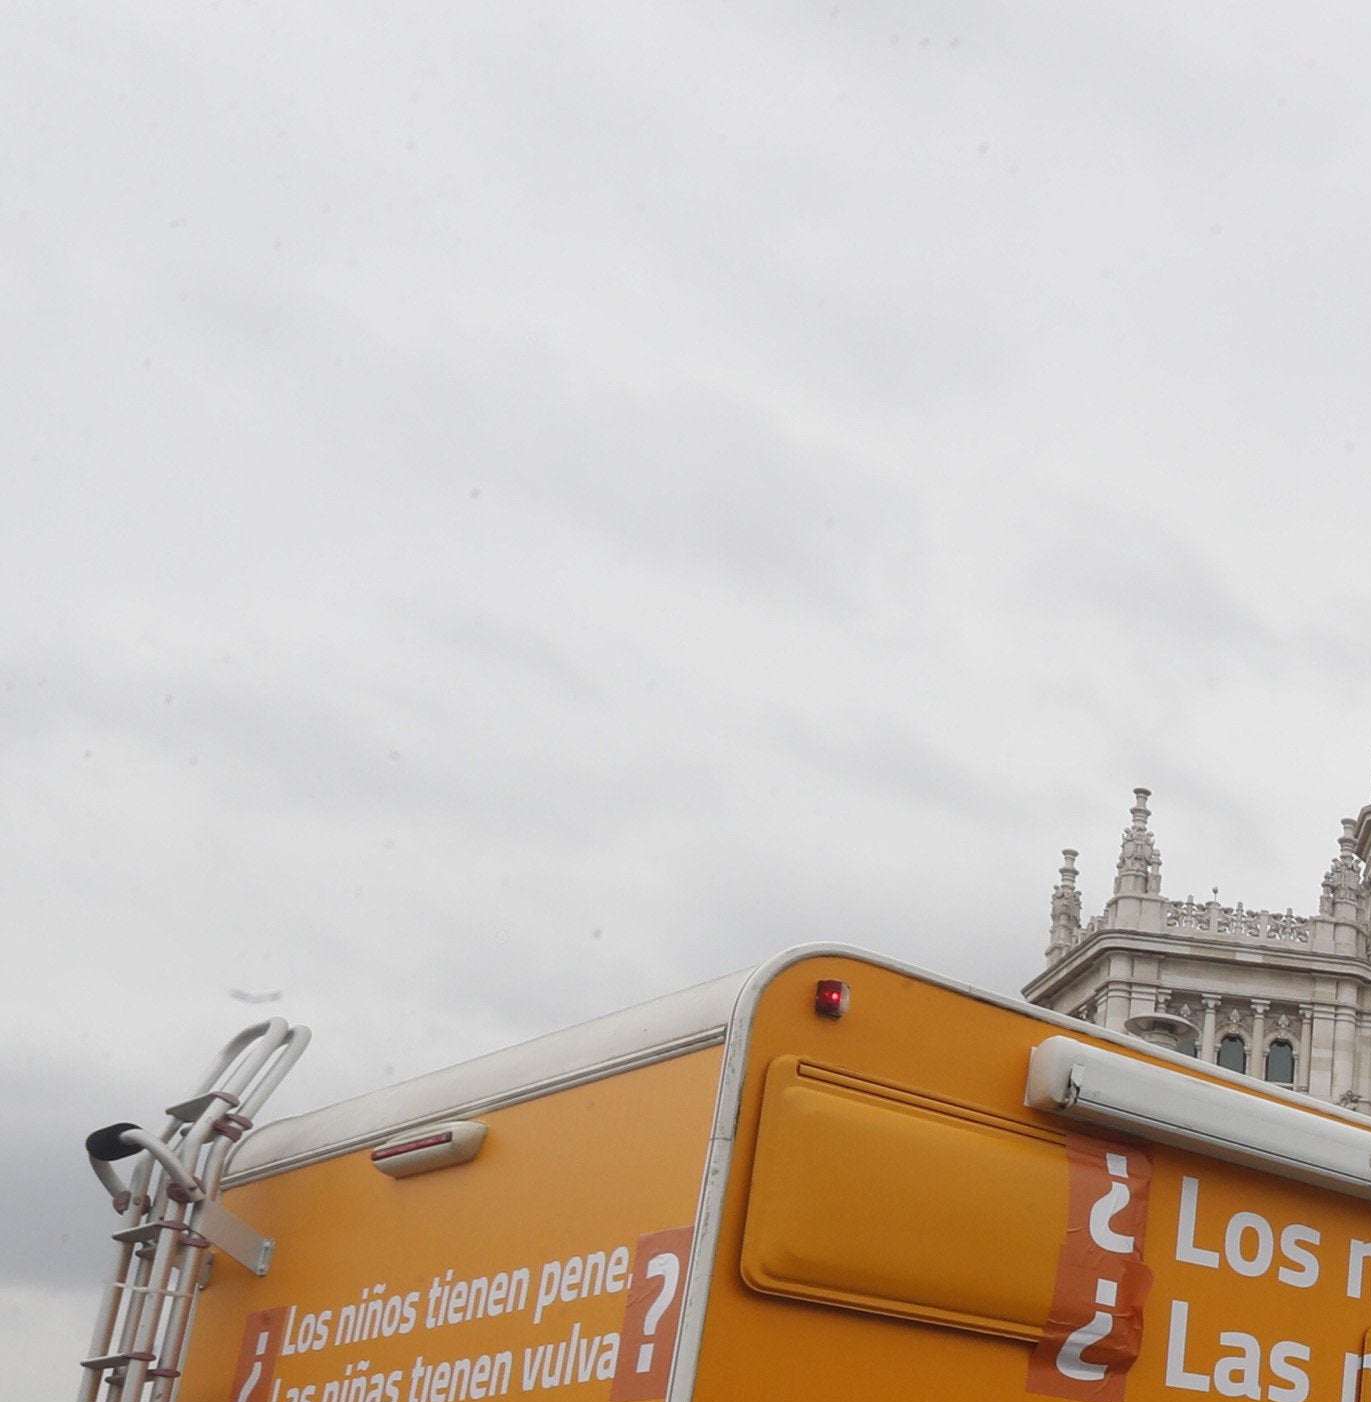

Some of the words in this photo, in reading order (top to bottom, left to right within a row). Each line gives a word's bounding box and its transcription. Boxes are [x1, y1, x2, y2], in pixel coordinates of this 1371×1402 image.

[1175, 1175, 1321, 1289] Los
[281, 1305, 332, 1356] Los
[335, 1283, 420, 1346] niños
[425, 1268, 530, 1329] tienen
[522, 1322, 621, 1392] vulva
